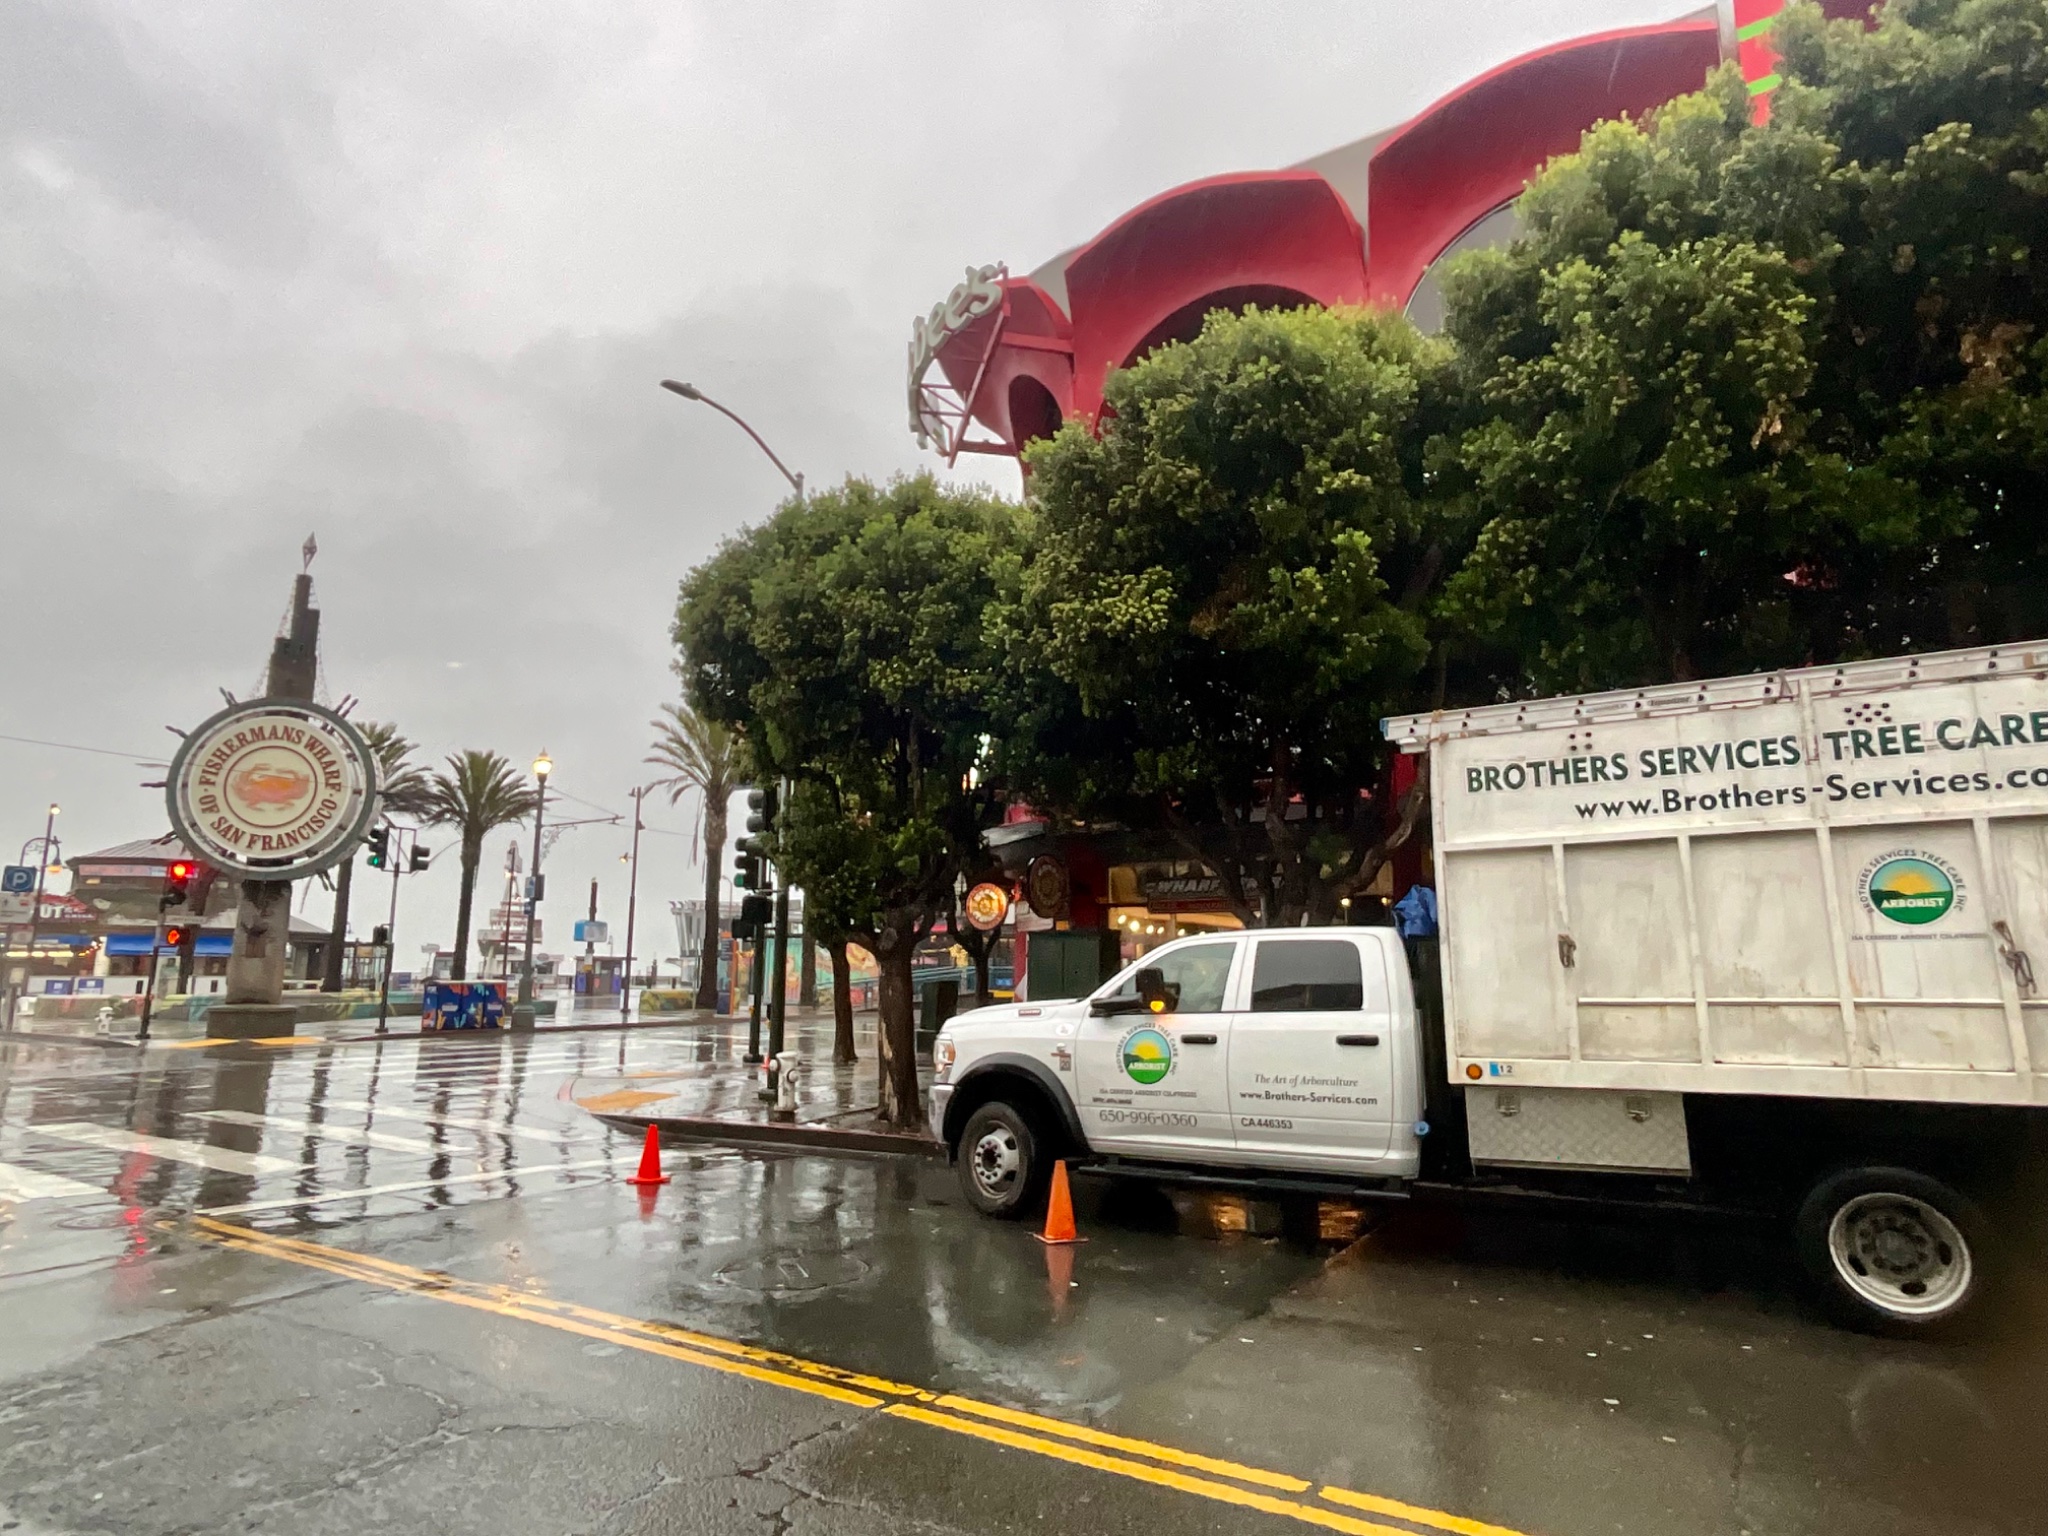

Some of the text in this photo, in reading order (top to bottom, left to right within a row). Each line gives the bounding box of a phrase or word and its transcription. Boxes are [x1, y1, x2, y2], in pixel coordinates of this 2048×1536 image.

[198, 724, 342, 793] FISHERMANS WHARF
[1467, 711, 2048, 793] BROTHERS SERVICES TREE CARE
[1575, 768, 2048, 819] www.Brothers-Services.co
[198, 794, 338, 851] OF SAN FRANCISCO
[1857, 868, 1875, 914] BROTHERS
[1869, 849, 1917, 868] SERVICES
[1921, 851, 1948, 867] TREE
[1946, 866, 1966, 891] CARE
[1880, 898, 1945, 908] ARBORIST
[1128, 1061, 1167, 1071] ARBORIST
[1254, 1073, 1271, 1084] The
[1272, 1074, 1287, 1085] Art
[1288, 1074, 1300, 1088] of
[1239, 1090, 1378, 1105] www.Brothers-Services.com
[1098, 1109, 1198, 1128] 650-996-0360
